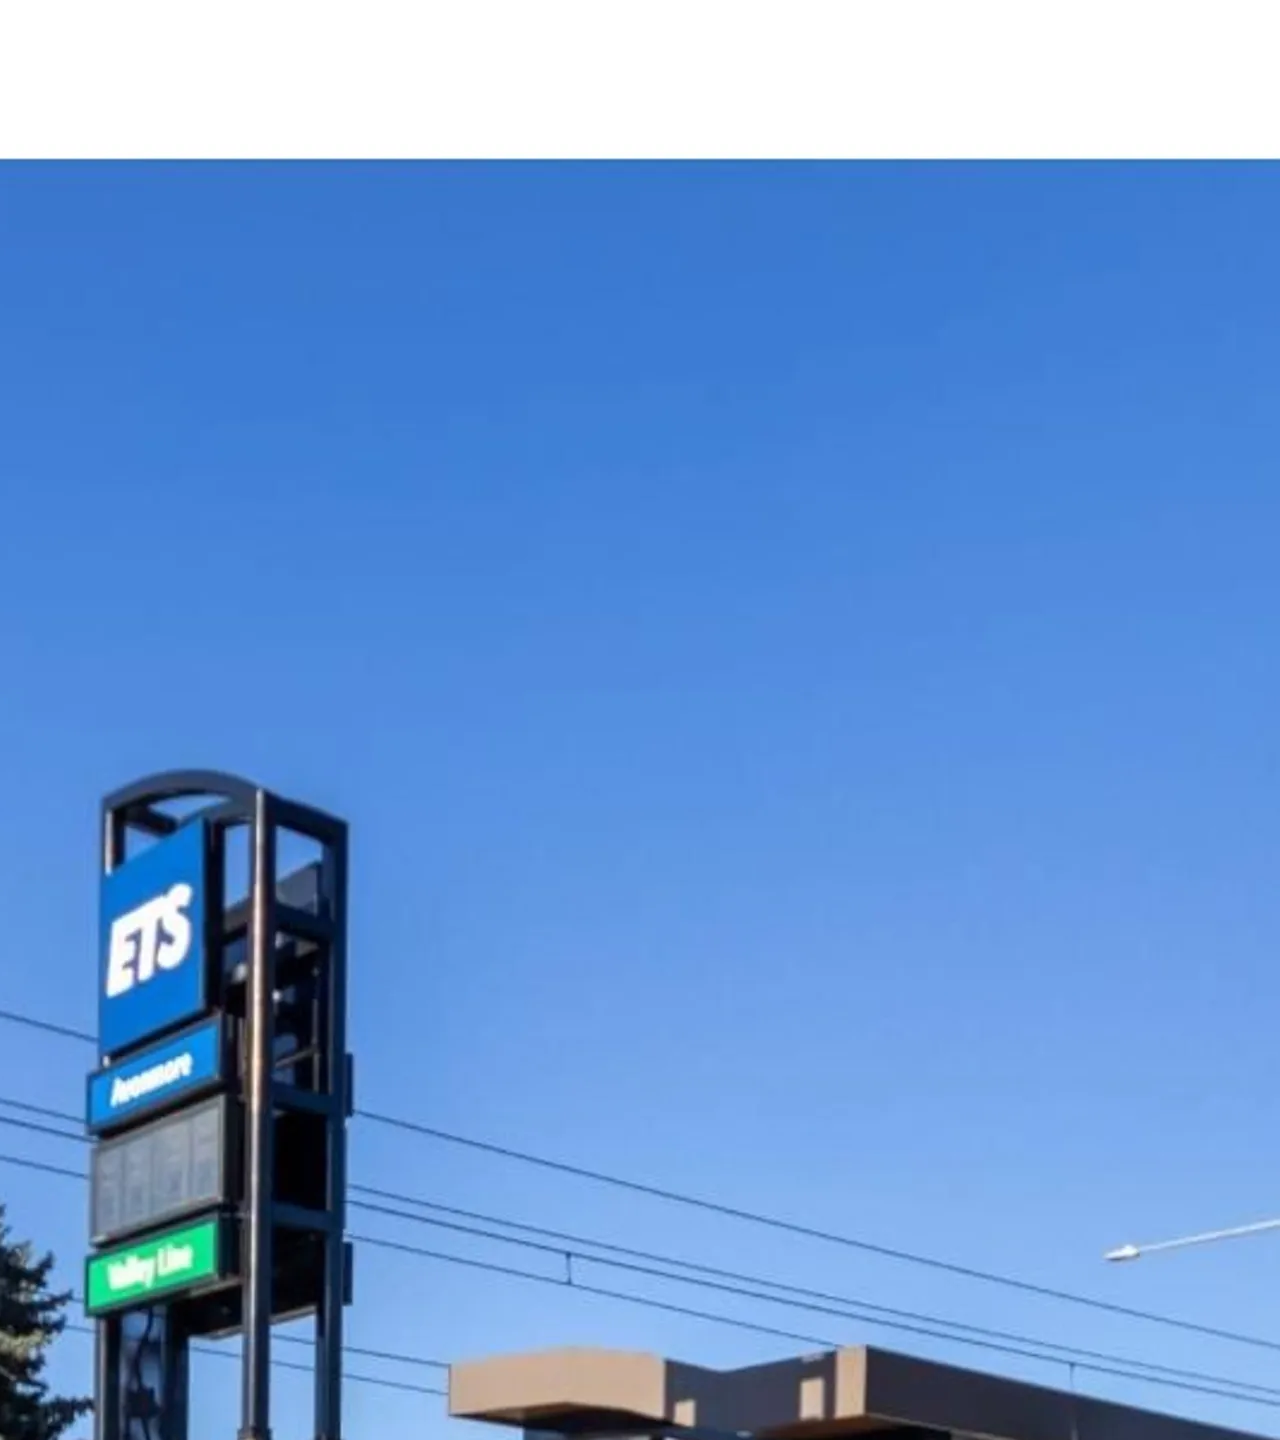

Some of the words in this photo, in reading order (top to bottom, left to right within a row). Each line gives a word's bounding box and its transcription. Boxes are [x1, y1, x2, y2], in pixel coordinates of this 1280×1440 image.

[106, 882, 192, 998] ETS
[107, 1254, 154, 1291] Valley
[157, 1243, 193, 1276] Line
